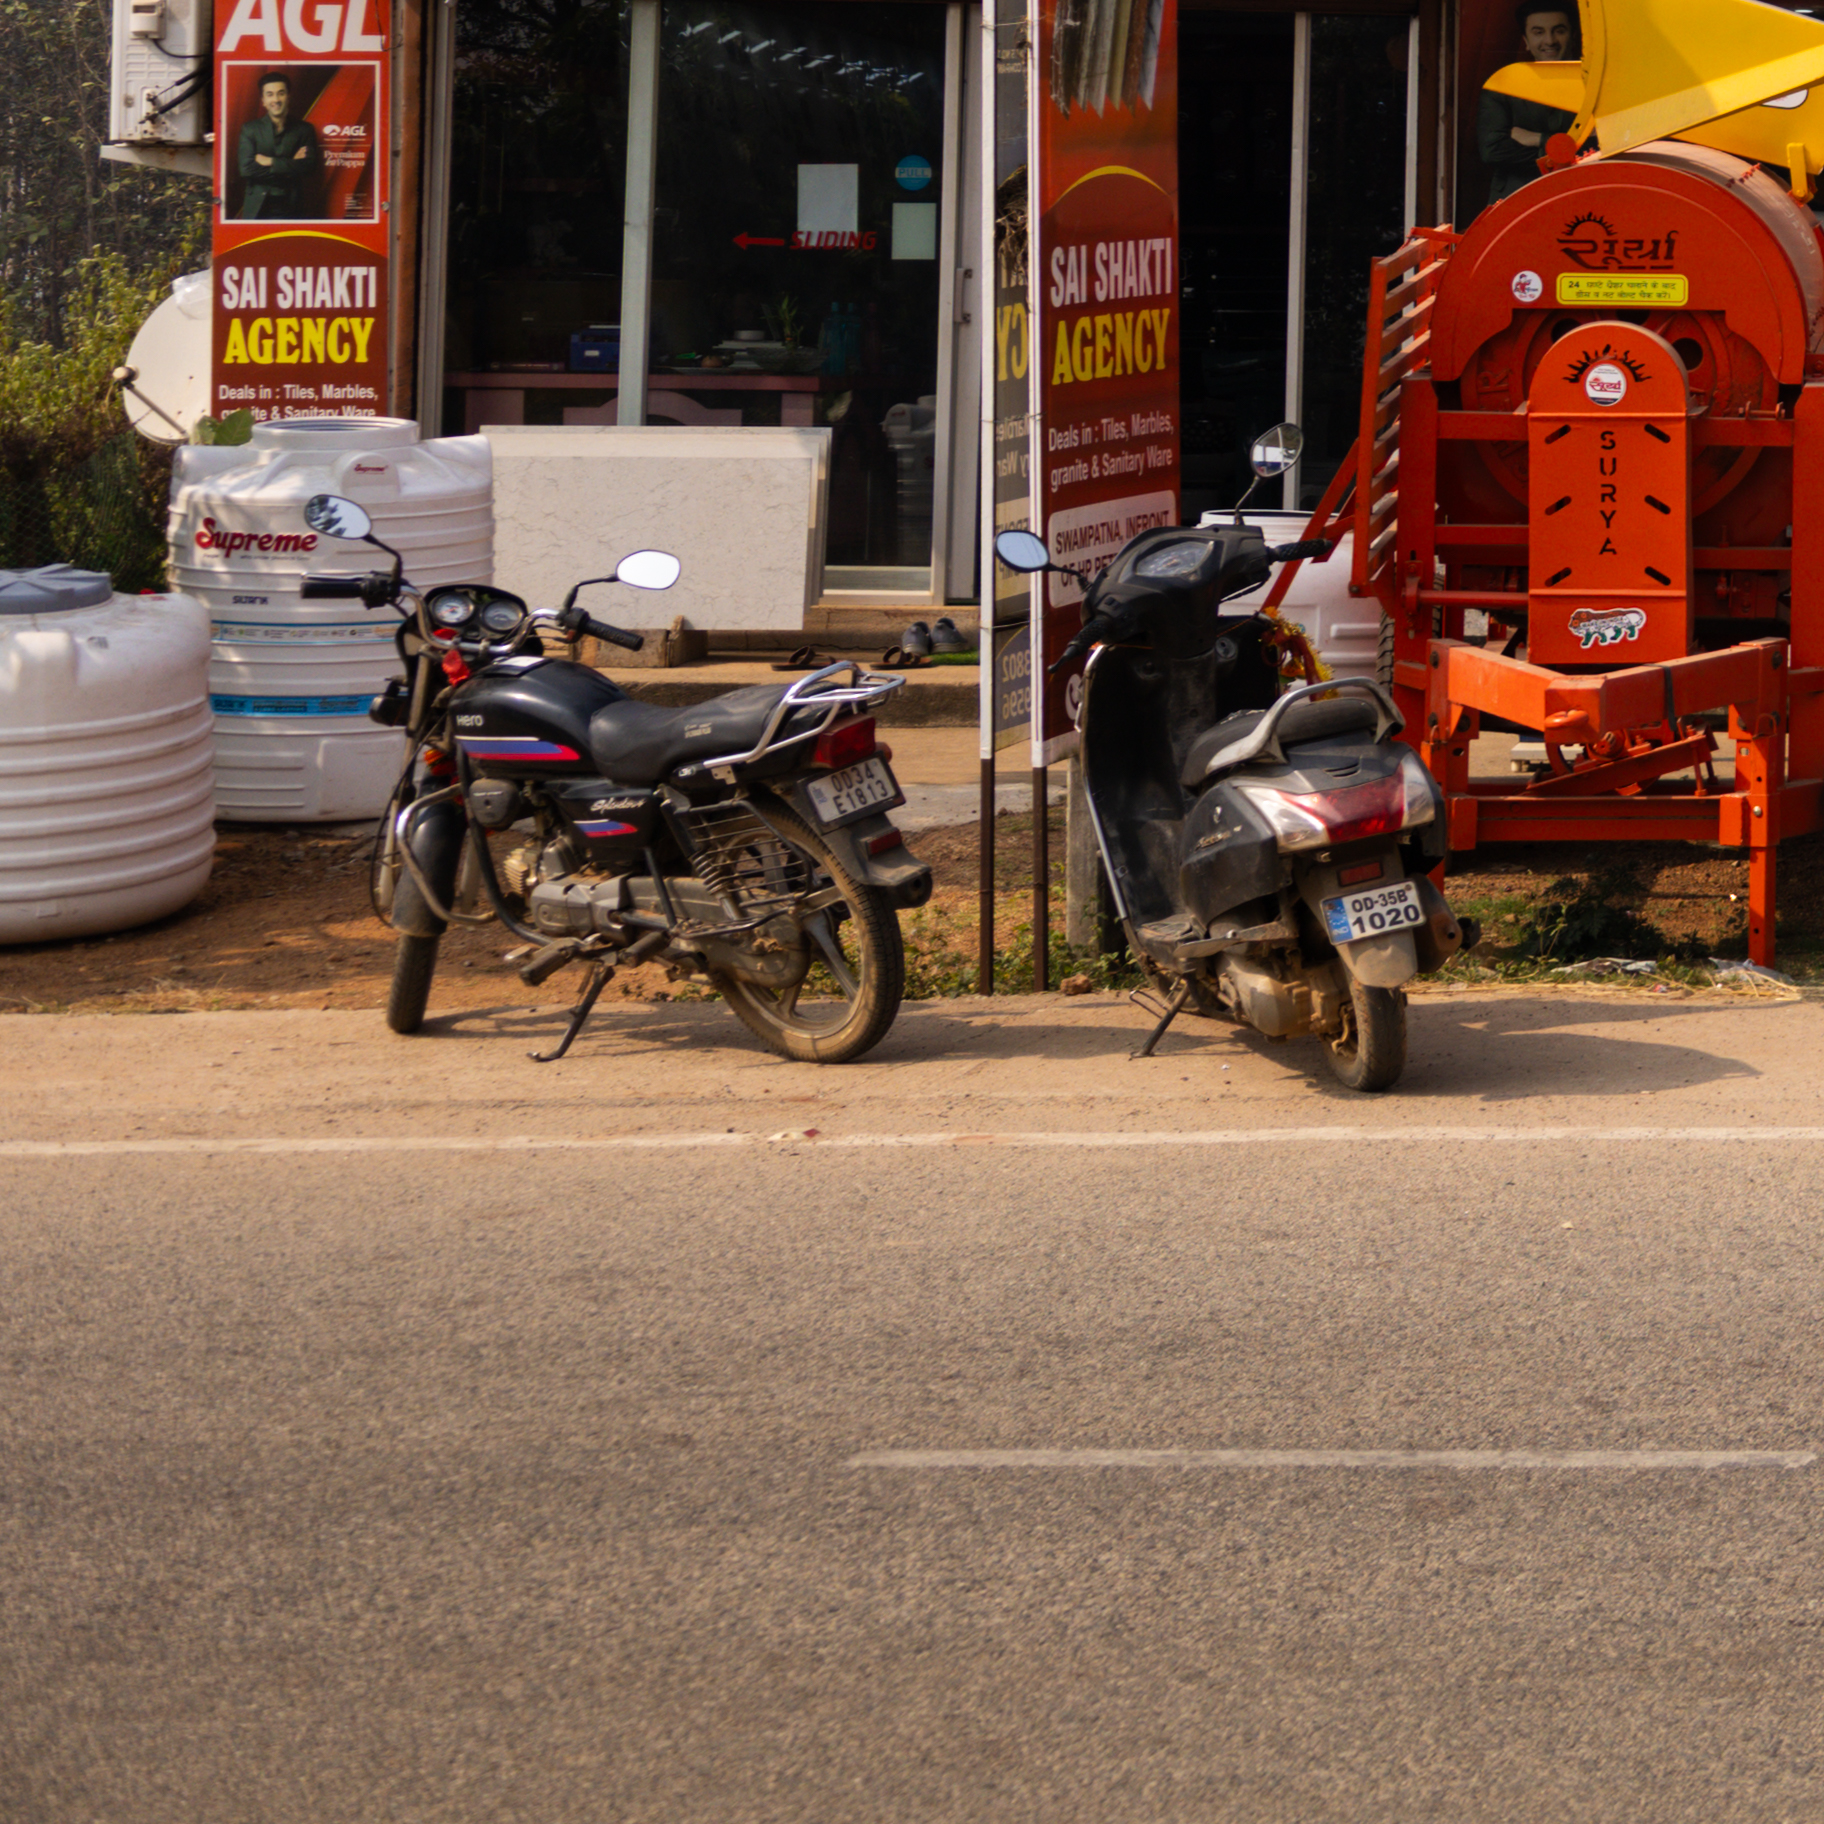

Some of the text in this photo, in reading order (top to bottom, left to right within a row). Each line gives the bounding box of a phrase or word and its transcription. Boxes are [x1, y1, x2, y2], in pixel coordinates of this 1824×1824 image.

[341, 125, 367, 136] AGL
[898, 167, 928, 177] PULL
[789, 230, 878, 250] SLIDING
[222, 266, 377, 309] SAI SHAKTI
[1050, 237, 1172, 308] SAI SHAKTI
[223, 317, 375, 365] AGENCY
[1051, 308, 1170, 386] AGENCY
[219, 384, 379, 402] Deals in Tiles, Marbles,
[271, 405, 280, 421] &
[1049, 424, 1079, 452] Deals
[1081, 422, 1092, 445] in
[1101, 417, 1128, 442] Tiles,
[1131, 411, 1174, 438] Marbles,
[1051, 445, 1173, 493] granite & Sanitary Ware
[1598, 429, 1618, 556] SURYA
[195, 517, 318, 558] Supreme
[1056, 520, 1123, 555] SWAMPATNA,
[1351, 888, 1409, 914] OD-35B
[1352, 904, 1421, 935] 1020
